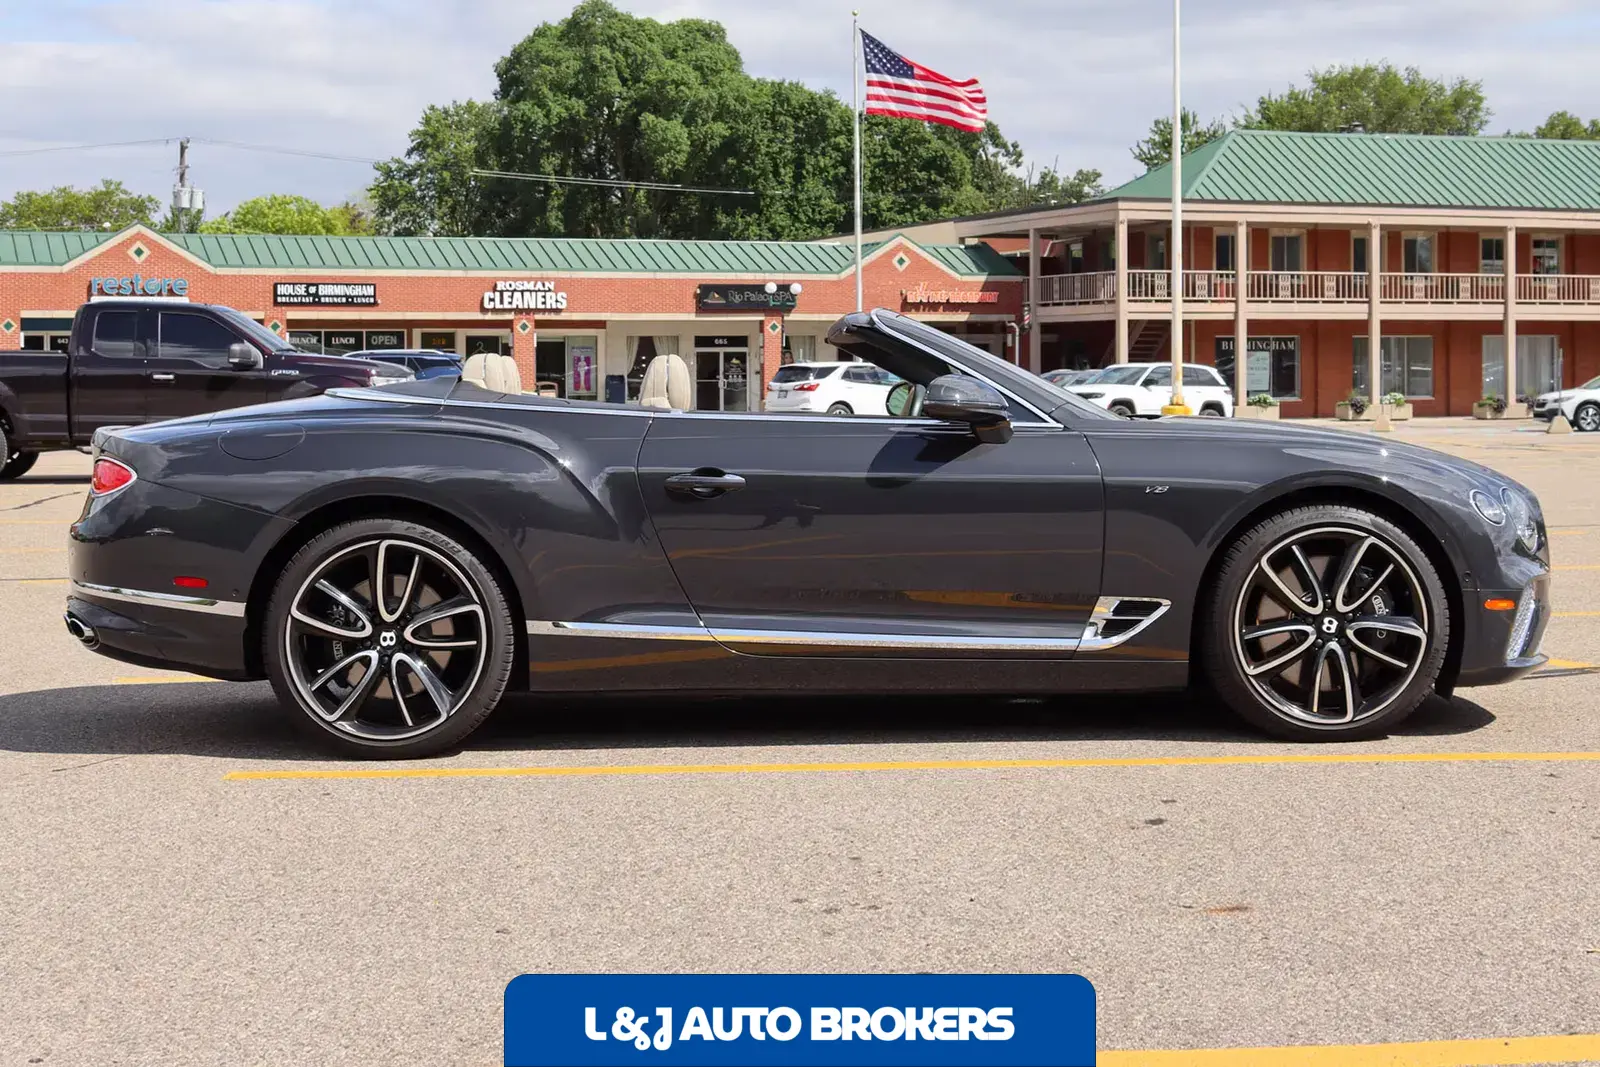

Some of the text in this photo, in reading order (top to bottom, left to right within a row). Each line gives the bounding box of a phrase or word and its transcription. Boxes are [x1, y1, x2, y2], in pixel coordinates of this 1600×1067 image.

[92, 273, 188, 295] restore
[496, 281, 555, 291] ROSMAN
[277, 284, 307, 295] HOUSE
[318, 285, 374, 296] BIRMINGHAM
[483, 291, 567, 309] CLEANERS
[728, 290, 792, 303] Rio Palac SPA
[331, 336, 355, 345] LUNCH
[371, 335, 397, 346] OPEN
[1221, 340, 1295, 350] BIMINGHAM
